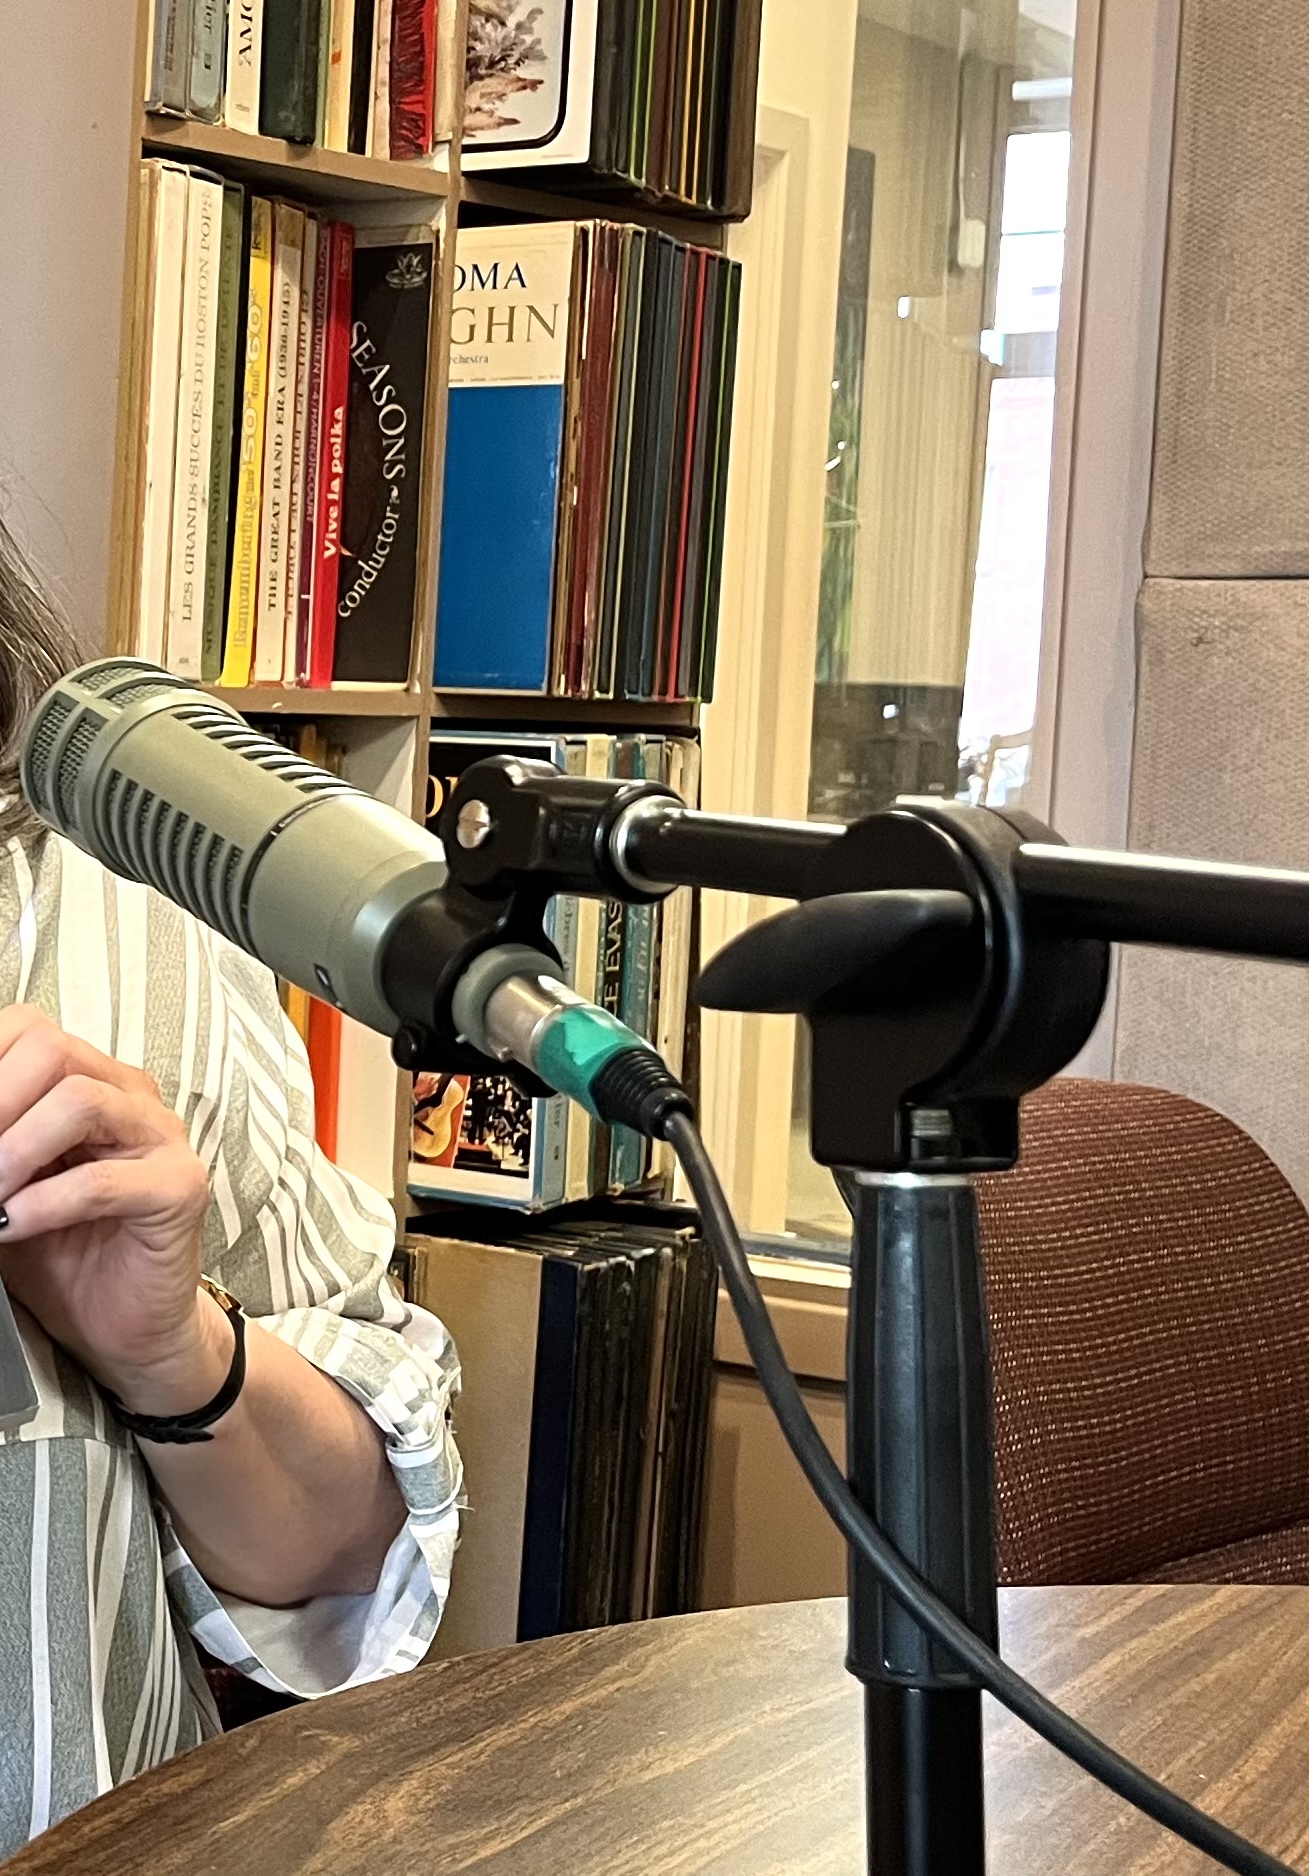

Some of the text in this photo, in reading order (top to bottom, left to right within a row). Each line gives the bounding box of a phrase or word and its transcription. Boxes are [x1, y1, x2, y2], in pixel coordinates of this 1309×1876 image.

[199, 193, 213, 252] POPS
[195, 257, 209, 347] BOSTON
[193, 352, 205, 384] DU
[274, 385, 287, 425] ERA
[349, 320, 407, 480] SEASONS
[272, 434, 284, 490] BAND
[323, 405, 344, 560] Vive la polka
[184, 483, 198, 575] GRANDS
[268, 497, 282, 564] GREAT
[266, 570, 278, 612] THE
[337, 505, 401, 618] conductor
[181, 582, 194, 622] LES
